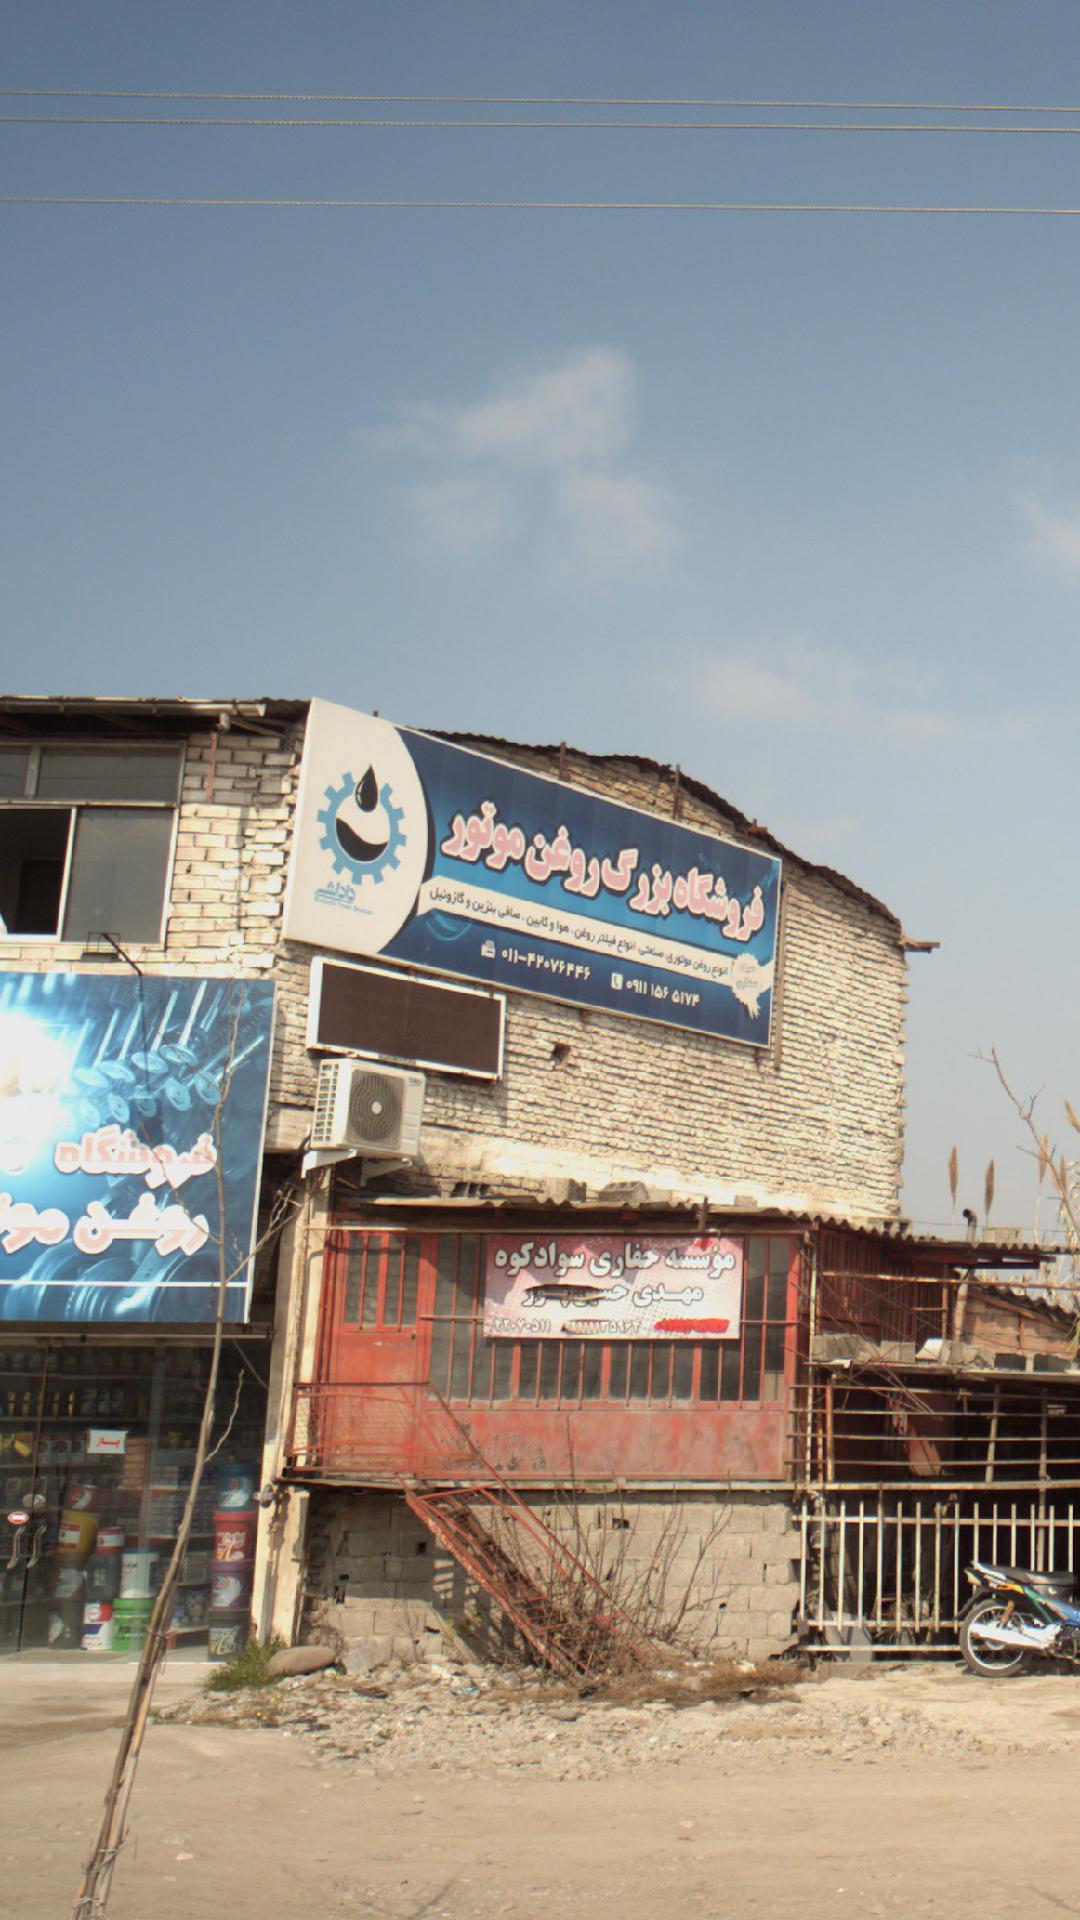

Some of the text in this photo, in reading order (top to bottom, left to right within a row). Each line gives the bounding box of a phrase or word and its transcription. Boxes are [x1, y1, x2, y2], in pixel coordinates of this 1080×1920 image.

[441, 800, 764, 941] فروشگاه بزرگ روغن موتور
[55, 1124, 217, 1189] فروشگاه
[73, 1193, 209, 1256] روغن
[588, 1242, 659, 1278] حفاری
[632, 1282, 704, 1307] مهدی
